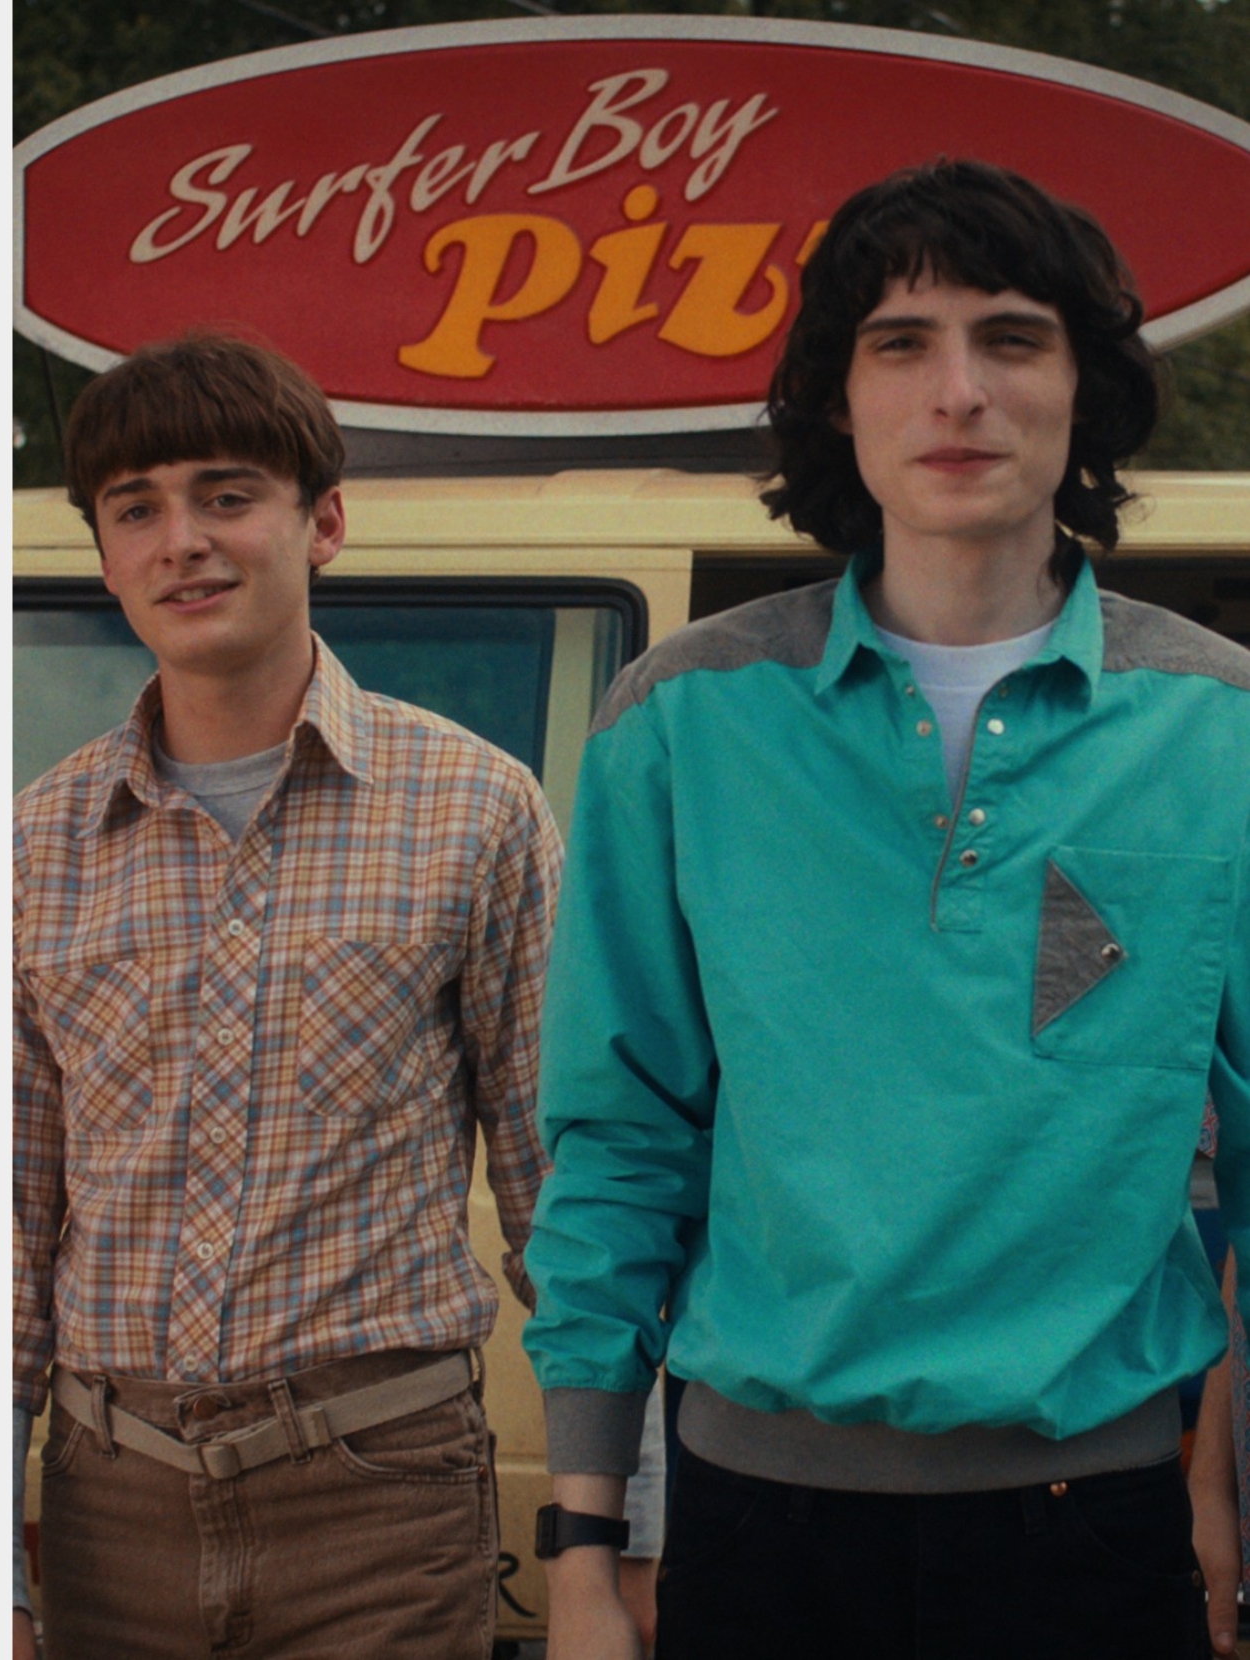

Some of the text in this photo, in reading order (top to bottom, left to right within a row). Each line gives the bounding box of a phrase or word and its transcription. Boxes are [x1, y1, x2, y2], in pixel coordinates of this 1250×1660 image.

[129, 67, 779, 265] Surfer Boy
[397, 183, 831, 379] Piz
